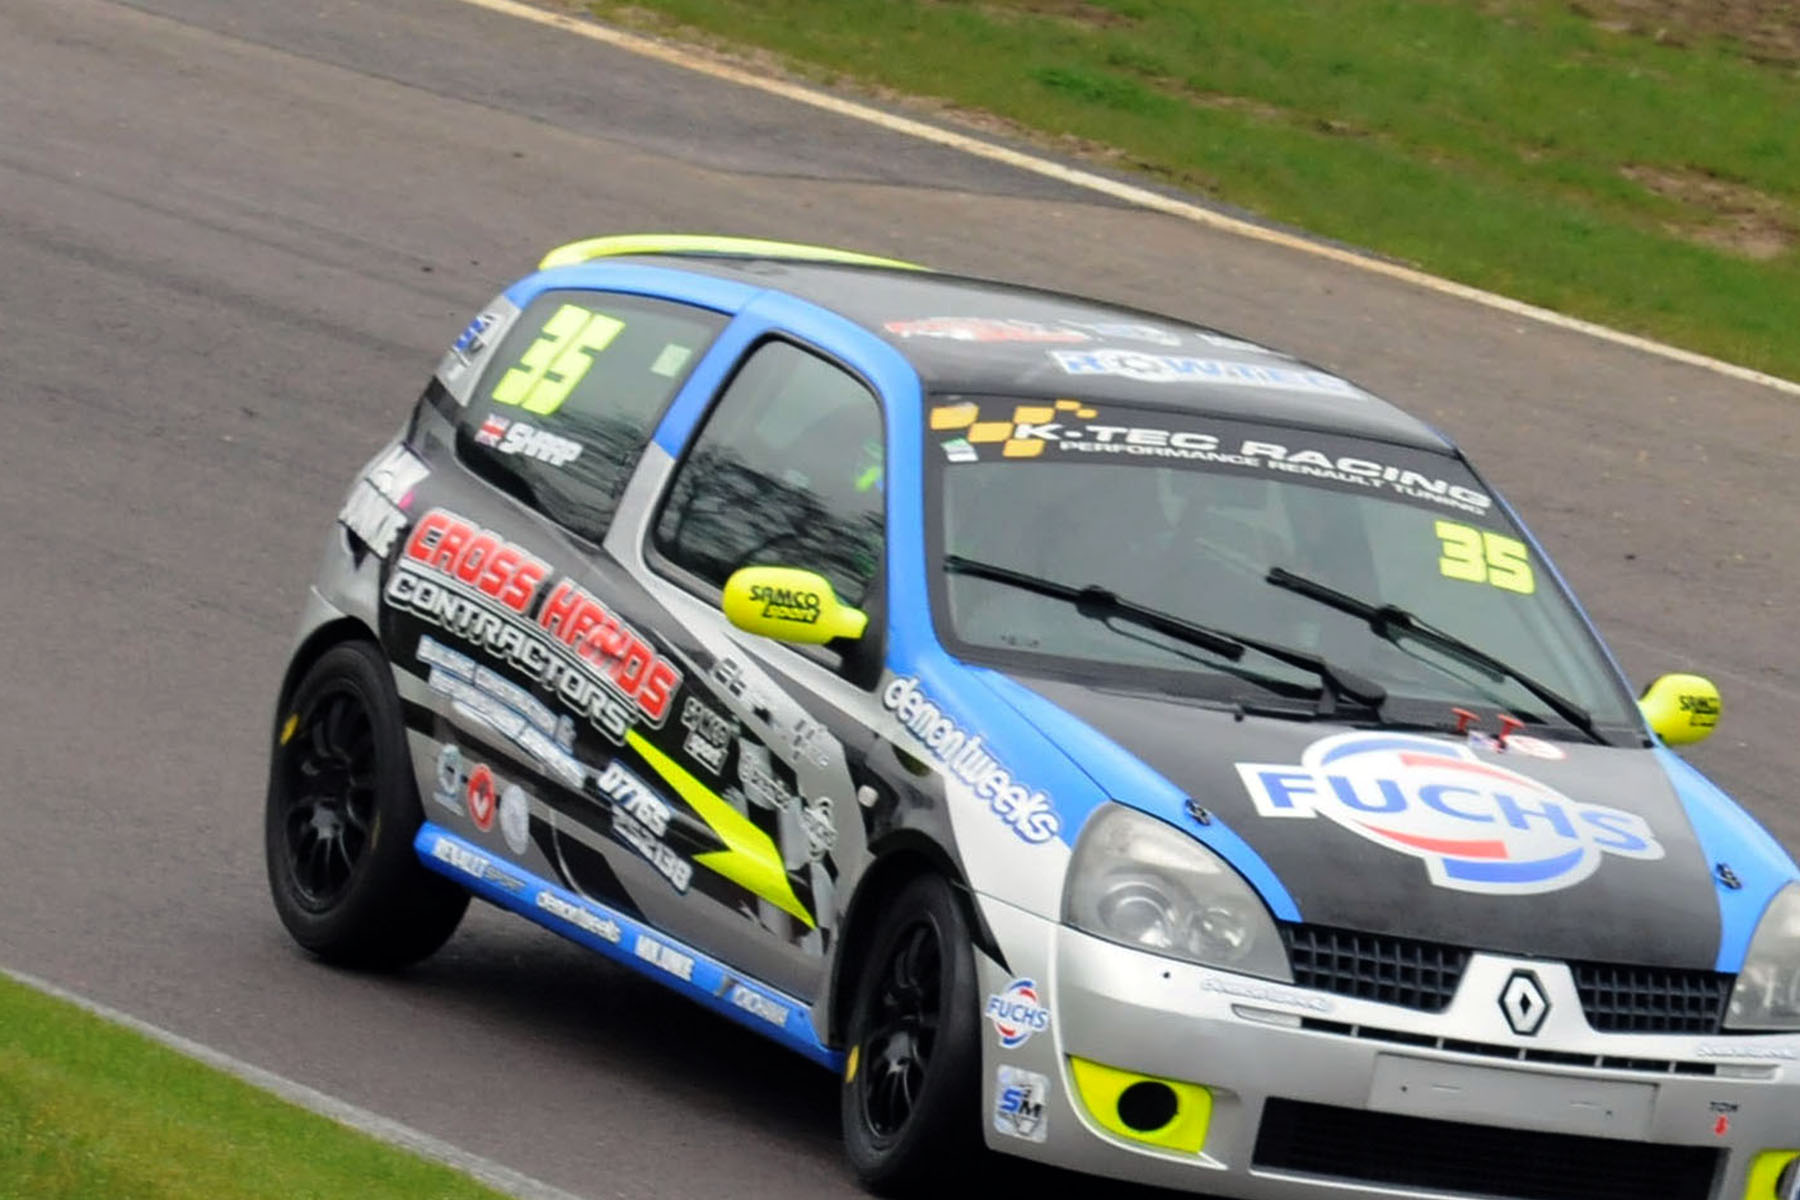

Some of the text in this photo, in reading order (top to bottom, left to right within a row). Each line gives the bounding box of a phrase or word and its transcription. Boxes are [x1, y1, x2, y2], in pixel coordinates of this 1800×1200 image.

[491, 304, 626, 416] 35
[1014, 423, 1491, 508] K-TEC RACING
[1060, 440, 1486, 516] PERFORMANCE RENAULT TUNING
[405, 511, 550, 614] CROSS
[749, 586, 820, 609] SAMCO
[1435, 521, 1535, 594] 35
[390, 570, 630, 738] CONTRACTORS
[1257, 768, 1650, 854] FUCHS
[987, 996, 1050, 1030] FUCHS
